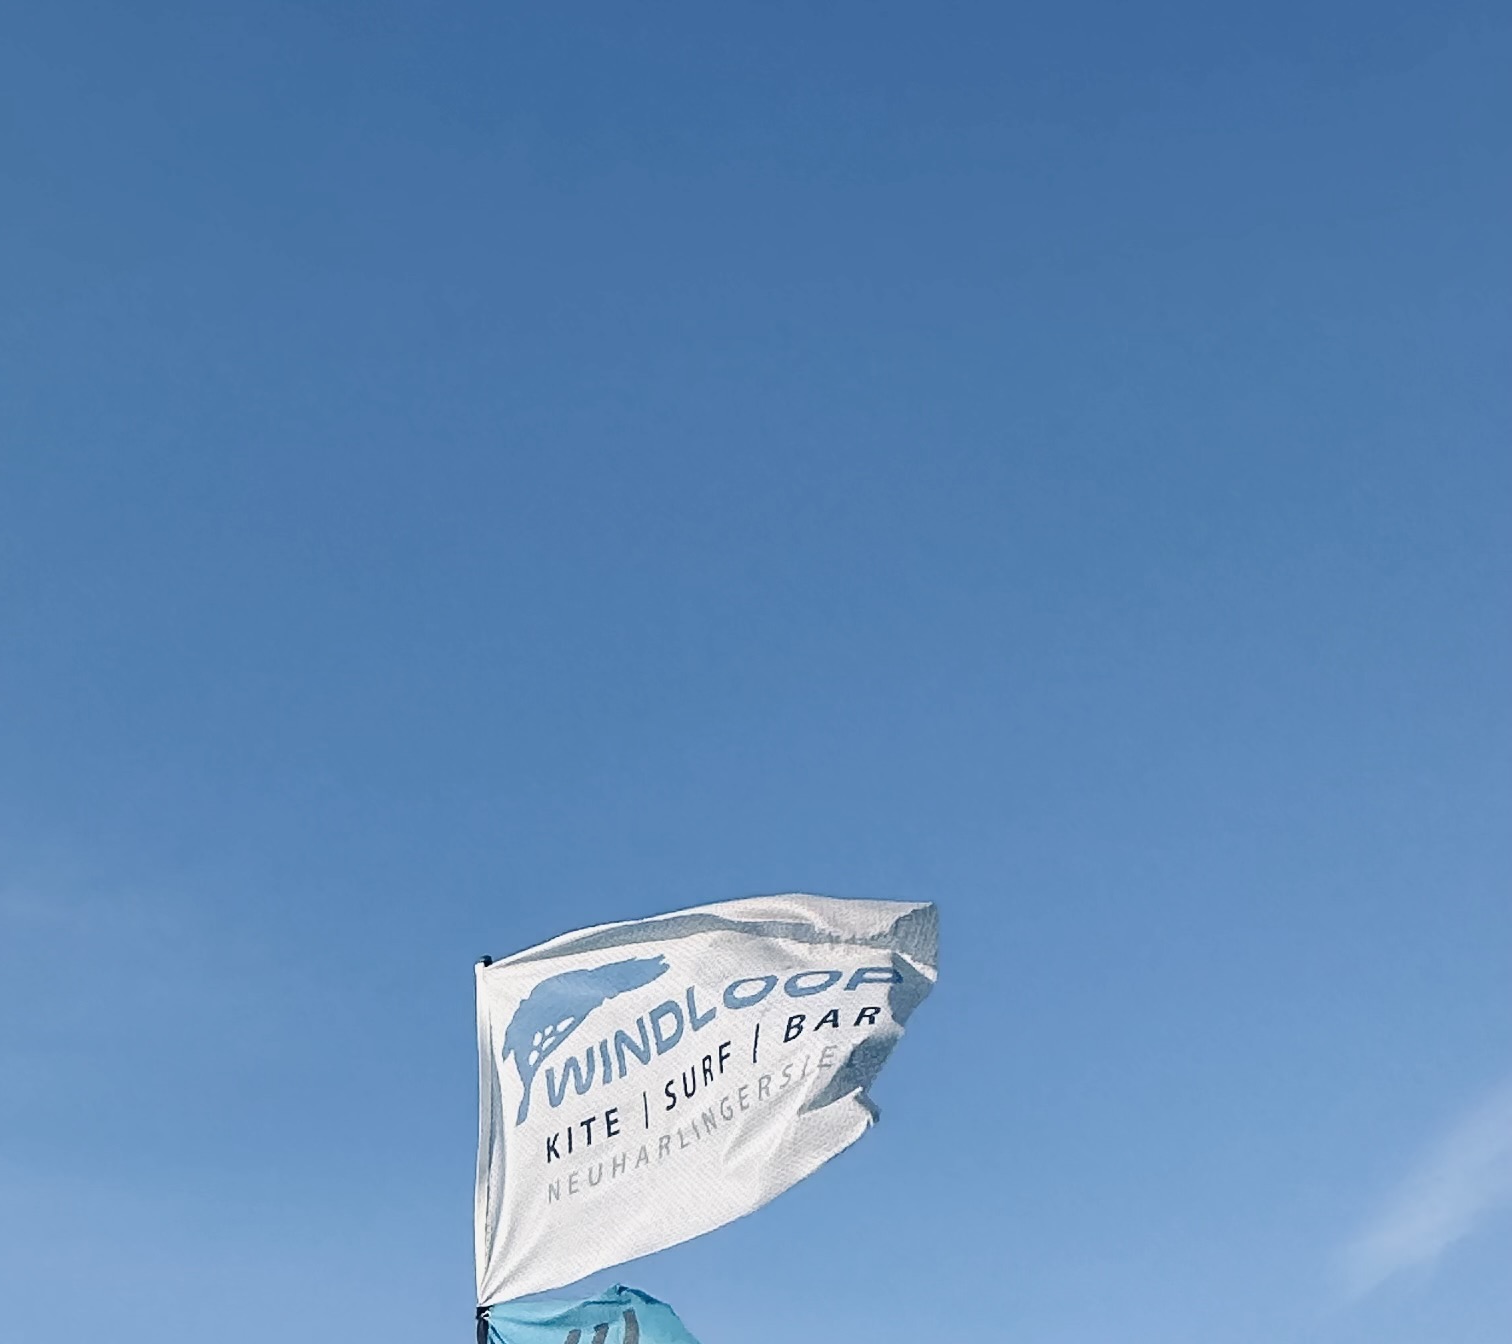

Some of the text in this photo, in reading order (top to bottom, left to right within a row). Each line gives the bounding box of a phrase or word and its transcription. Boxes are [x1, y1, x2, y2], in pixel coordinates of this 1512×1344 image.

[544, 967, 904, 1108] WINDLOOP
[546, 1107, 622, 1163] KITE
[665, 1040, 732, 1112] SURF
[782, 1006, 882, 1043] BAR
